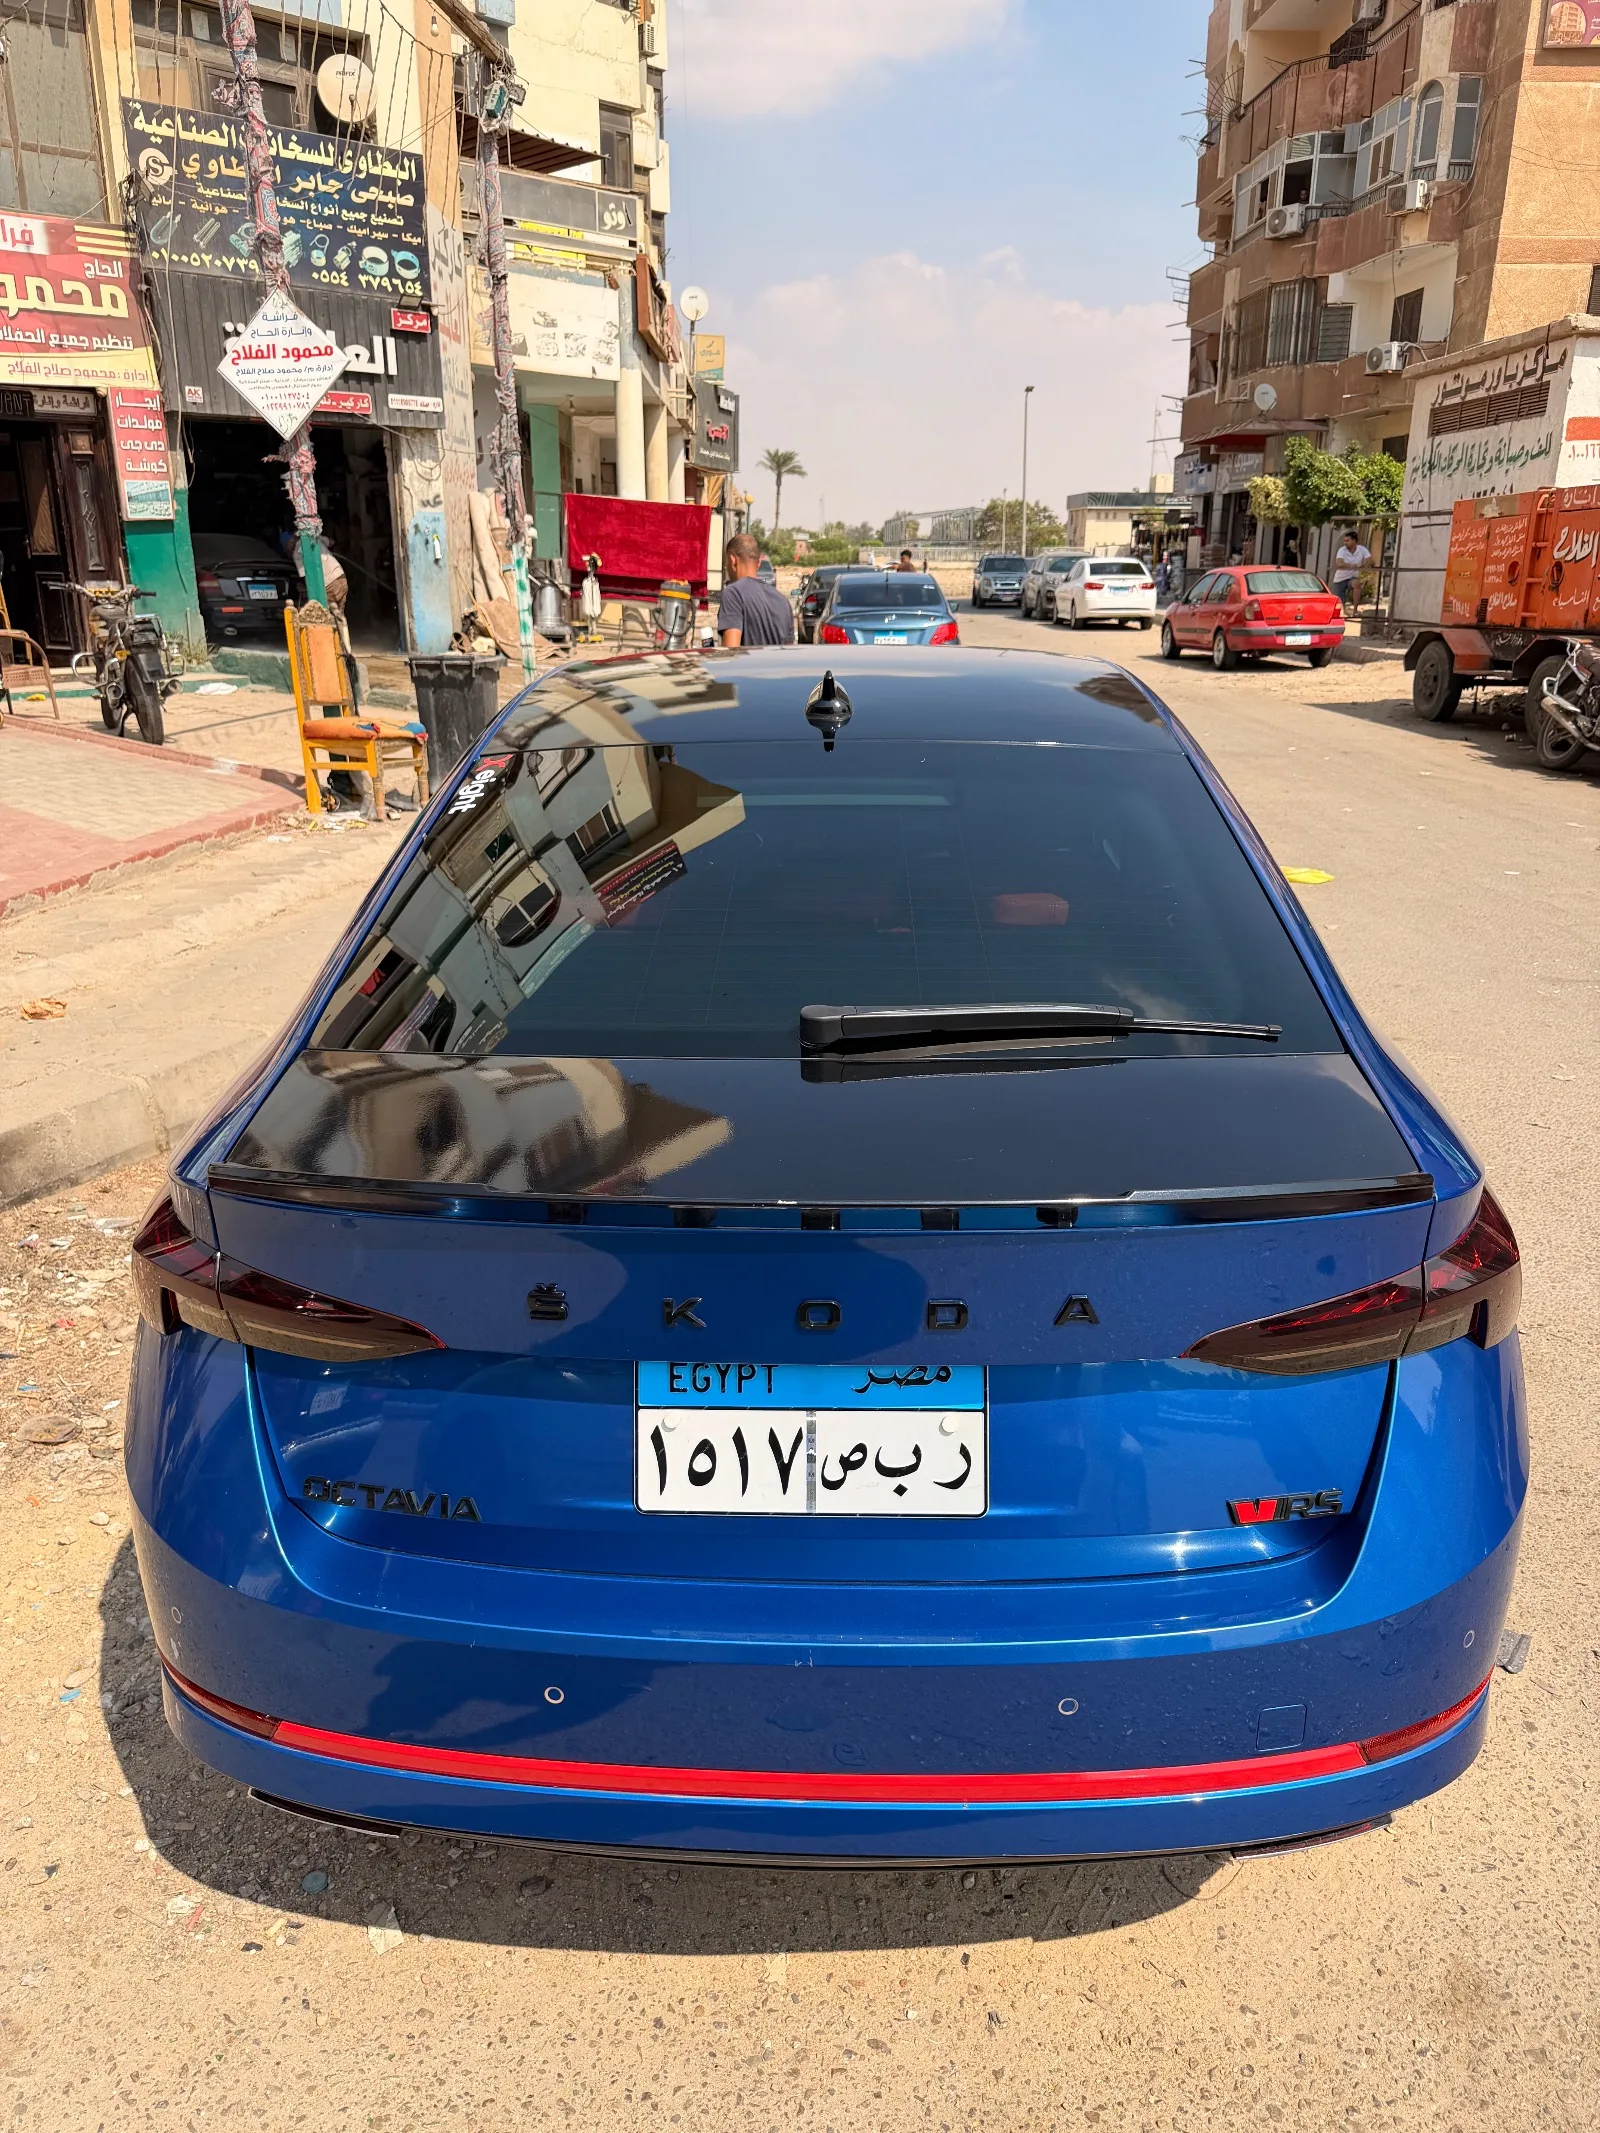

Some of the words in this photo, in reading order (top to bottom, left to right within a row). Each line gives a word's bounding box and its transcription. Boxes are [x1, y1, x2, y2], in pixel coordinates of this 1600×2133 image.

[129, 101, 236, 149] الصناعية
[289, 172, 343, 199] جابر
[276, 196, 309, 210] السخا
[341, 206, 367, 220] جميع
[371, 213, 404, 226] تصنيع
[0, 218, 35, 248] فرا
[402, 232, 422, 244] ميكا
[83, 258, 124, 279] الحاج
[151, 247, 261, 275] ٠١٠٠٥٢٠٧٣٩
[311, 269, 350, 287] ٠٥٥٤
[0, 273, 130, 319] محمو
[262, 311, 299, 323] فراشة
[396, 312, 428, 330] مركز
[0, 325, 46, 344] الحفلا
[49, 333, 90, 350] جميع
[251, 327, 280, 339] الحاج
[92, 334, 134, 351] تنظيم
[231, 343, 277, 366] الفلاح
[281, 345, 334, 362] محمود
[8, 361, 41, 375] الفلاح
[44, 363, 72, 377] صلاح
[75, 367, 117, 380] محمود
[235, 366, 256, 377] الفلاح
[257, 367, 275, 377] صلاح
[276, 366, 303, 377] محمود
[116, 390, 161, 412] إيجار
[187, 388, 201, 397] AK
[117, 414, 163, 431] مولدات
[126, 457, 168, 474] كوشة
[1553, 526, 1600, 569] الفلاح
[526, 1282, 1100, 1331] ŠKODA
[668, 1362, 780, 1394] EGYPT
[850, 1364, 953, 1394] مصر
[649, 1424, 804, 1497] ١٥١٧
[303, 1474, 482, 1522] OCTAVIA
